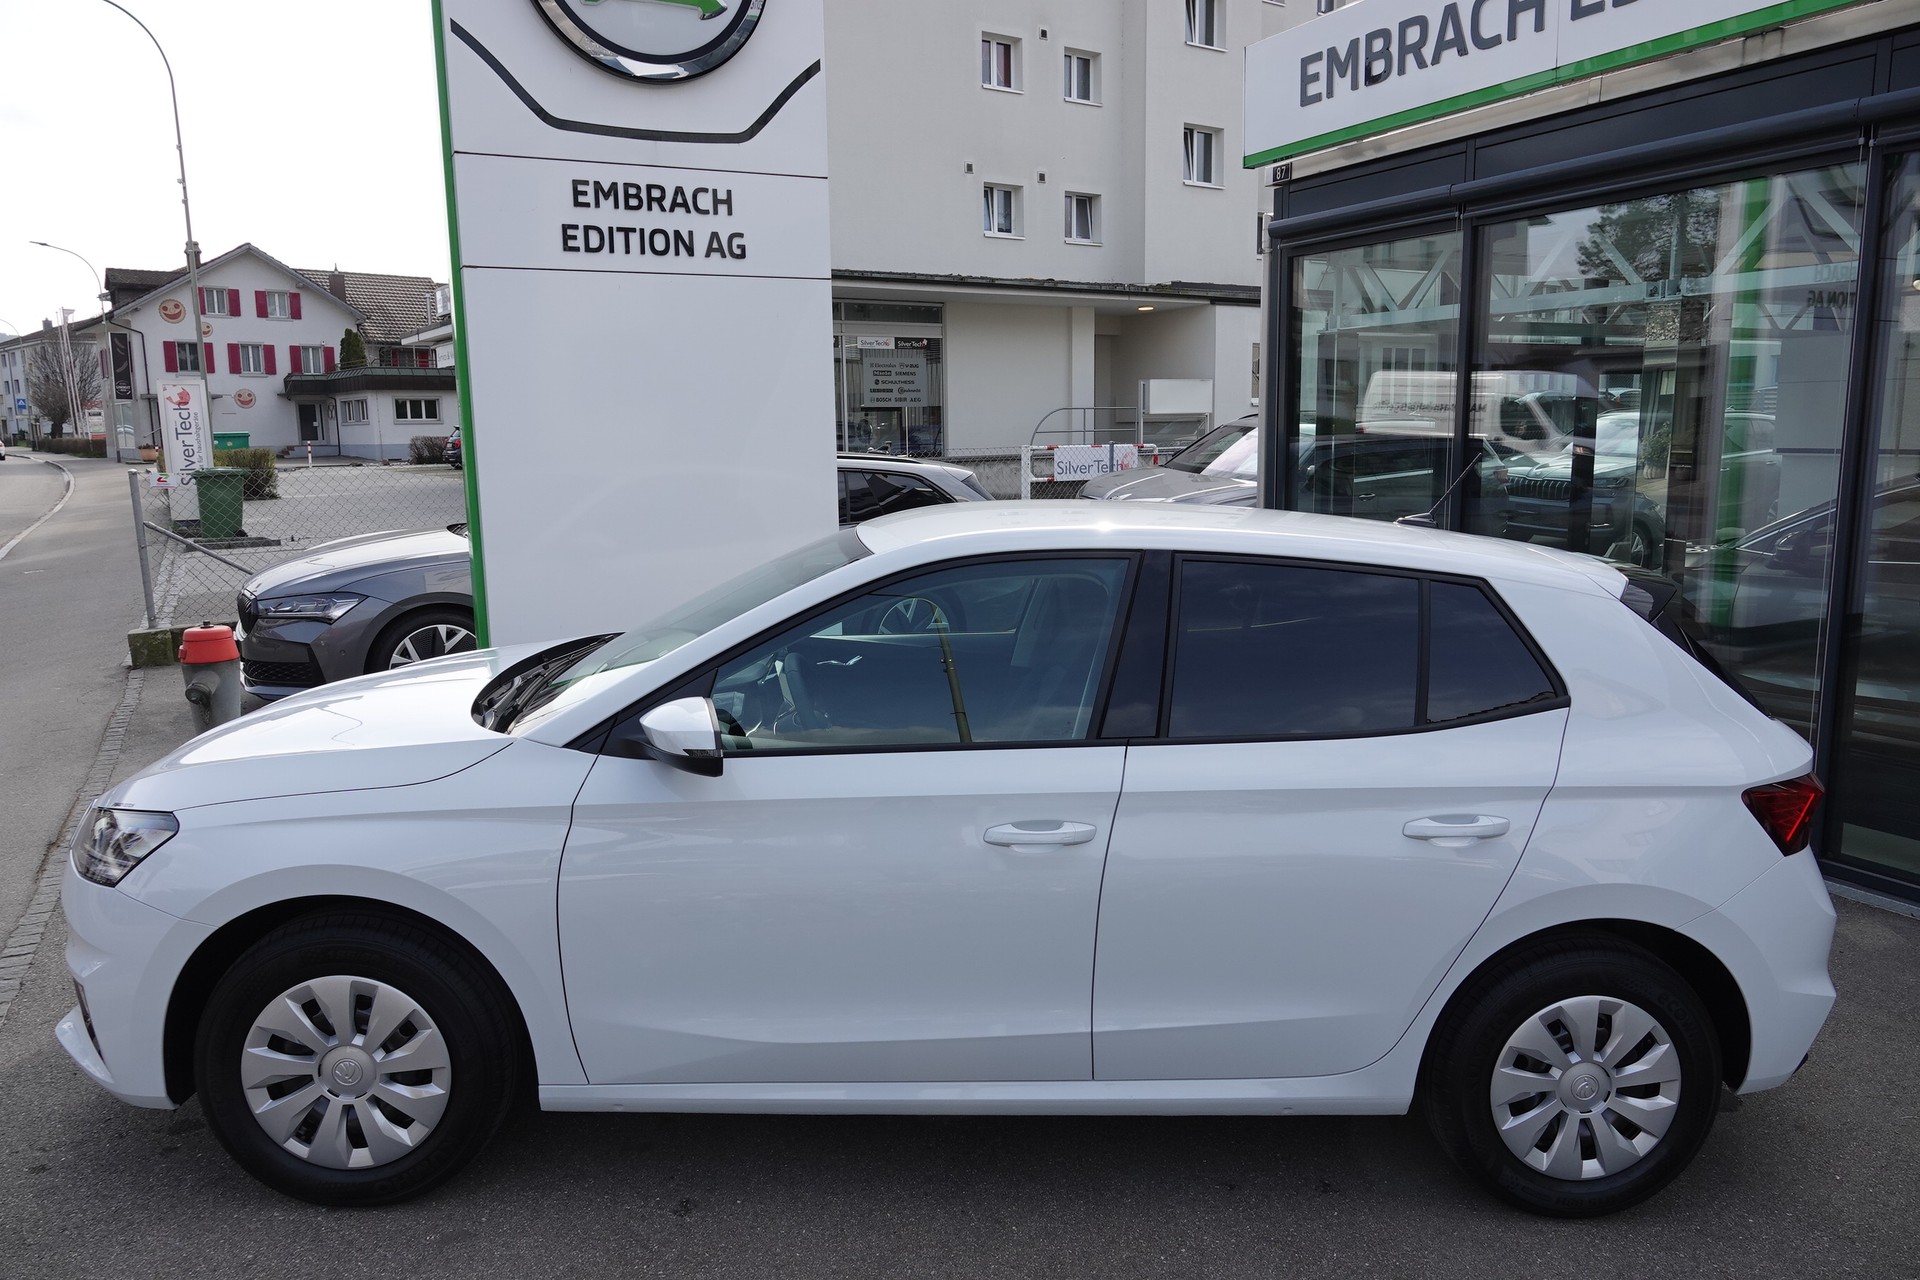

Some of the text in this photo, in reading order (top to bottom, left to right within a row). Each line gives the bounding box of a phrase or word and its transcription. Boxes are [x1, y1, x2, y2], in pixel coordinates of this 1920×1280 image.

[1300, 0, 1545, 107] EMBRACH
[1276, 166, 1286, 180] 87
[571, 179, 733, 216] EMBRACH
[561, 223, 747, 259] EDITION AG
[1056, 459, 1124, 475] SilverTeh
